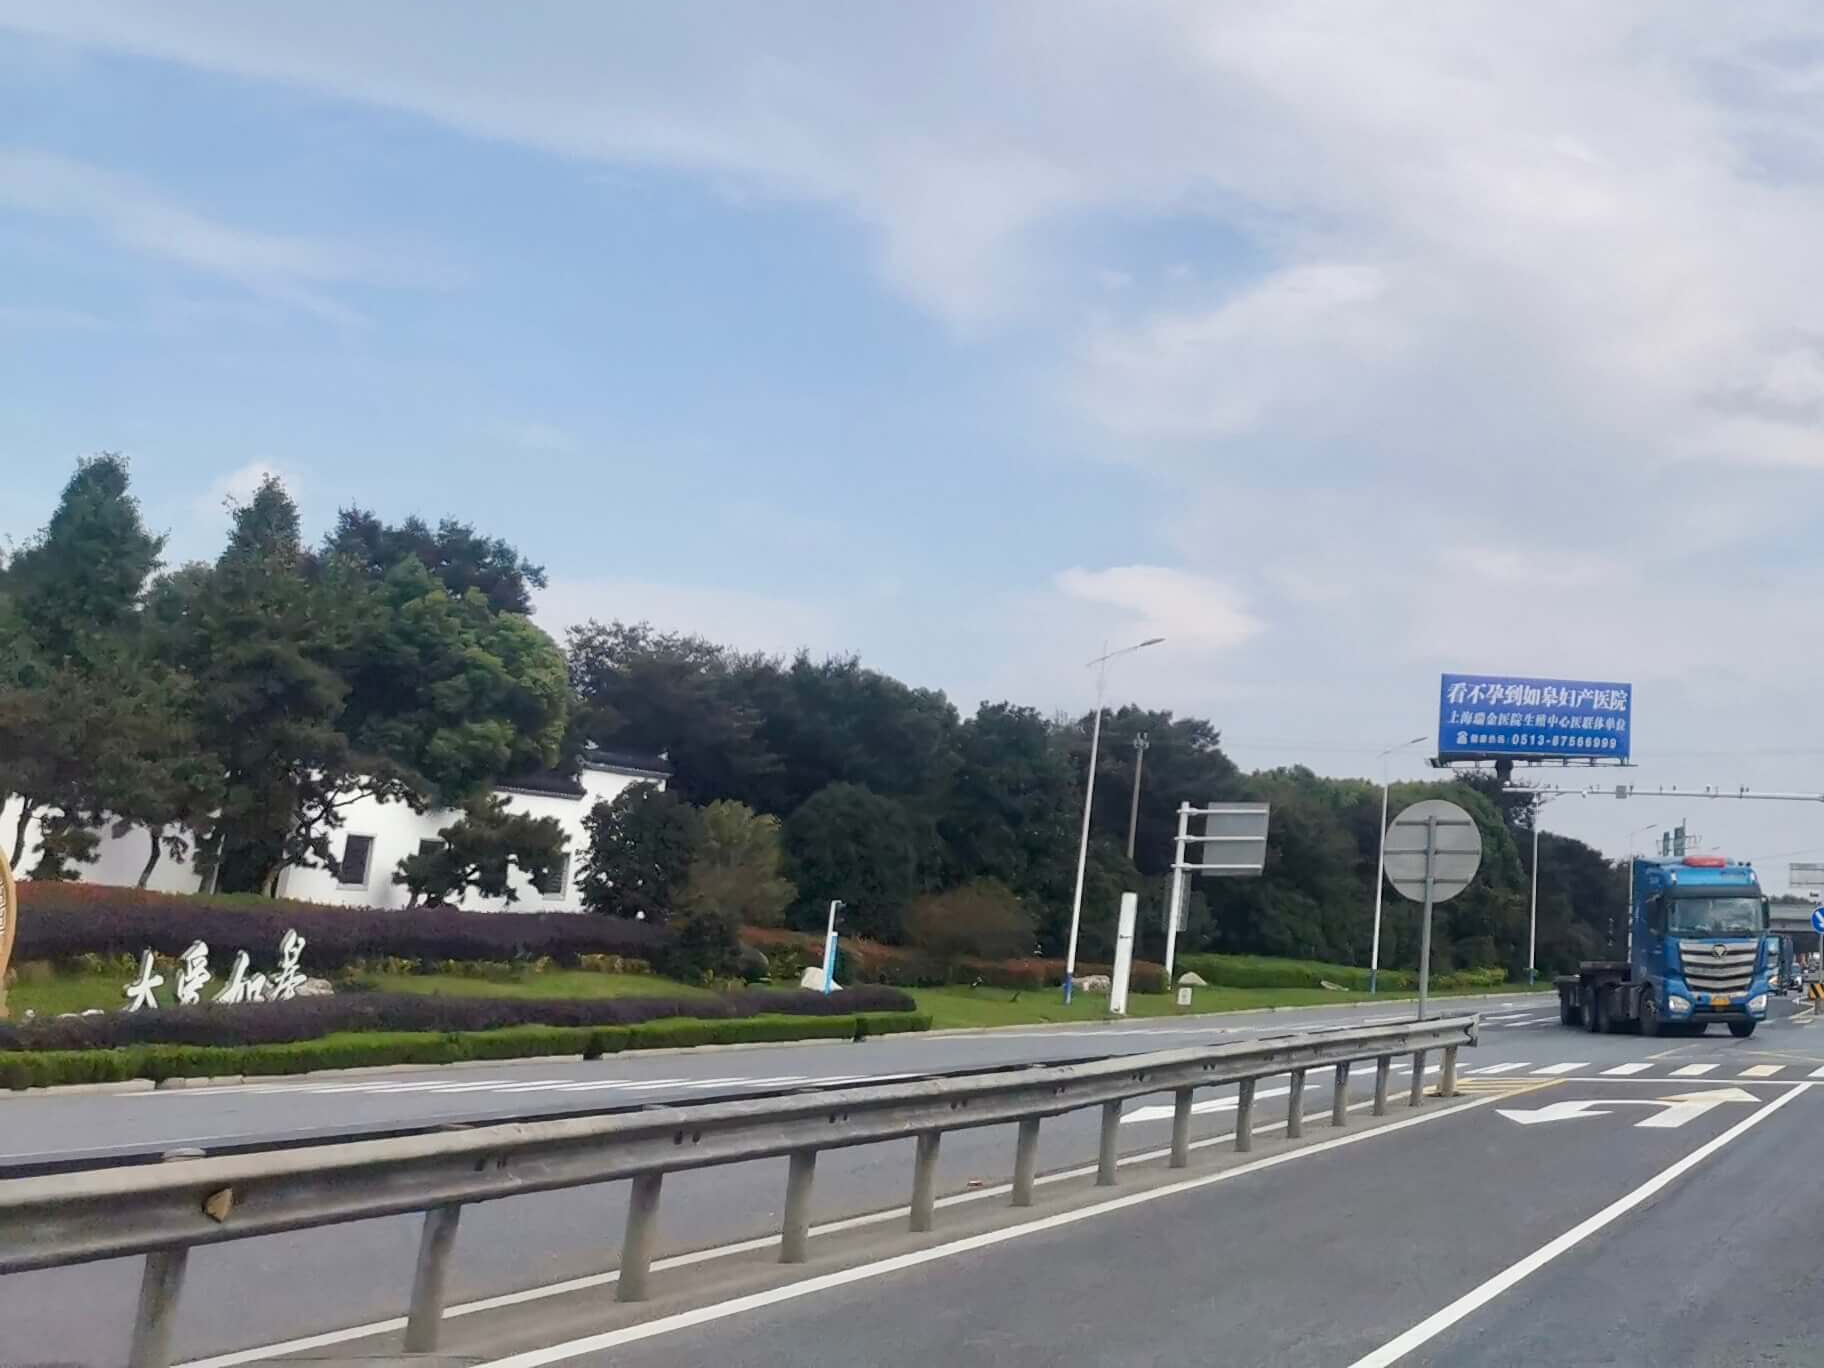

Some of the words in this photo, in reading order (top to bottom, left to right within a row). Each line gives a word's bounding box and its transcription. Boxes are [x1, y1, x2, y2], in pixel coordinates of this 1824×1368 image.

[1448, 682, 1628, 711] 看不孕到如皋妇产医院
